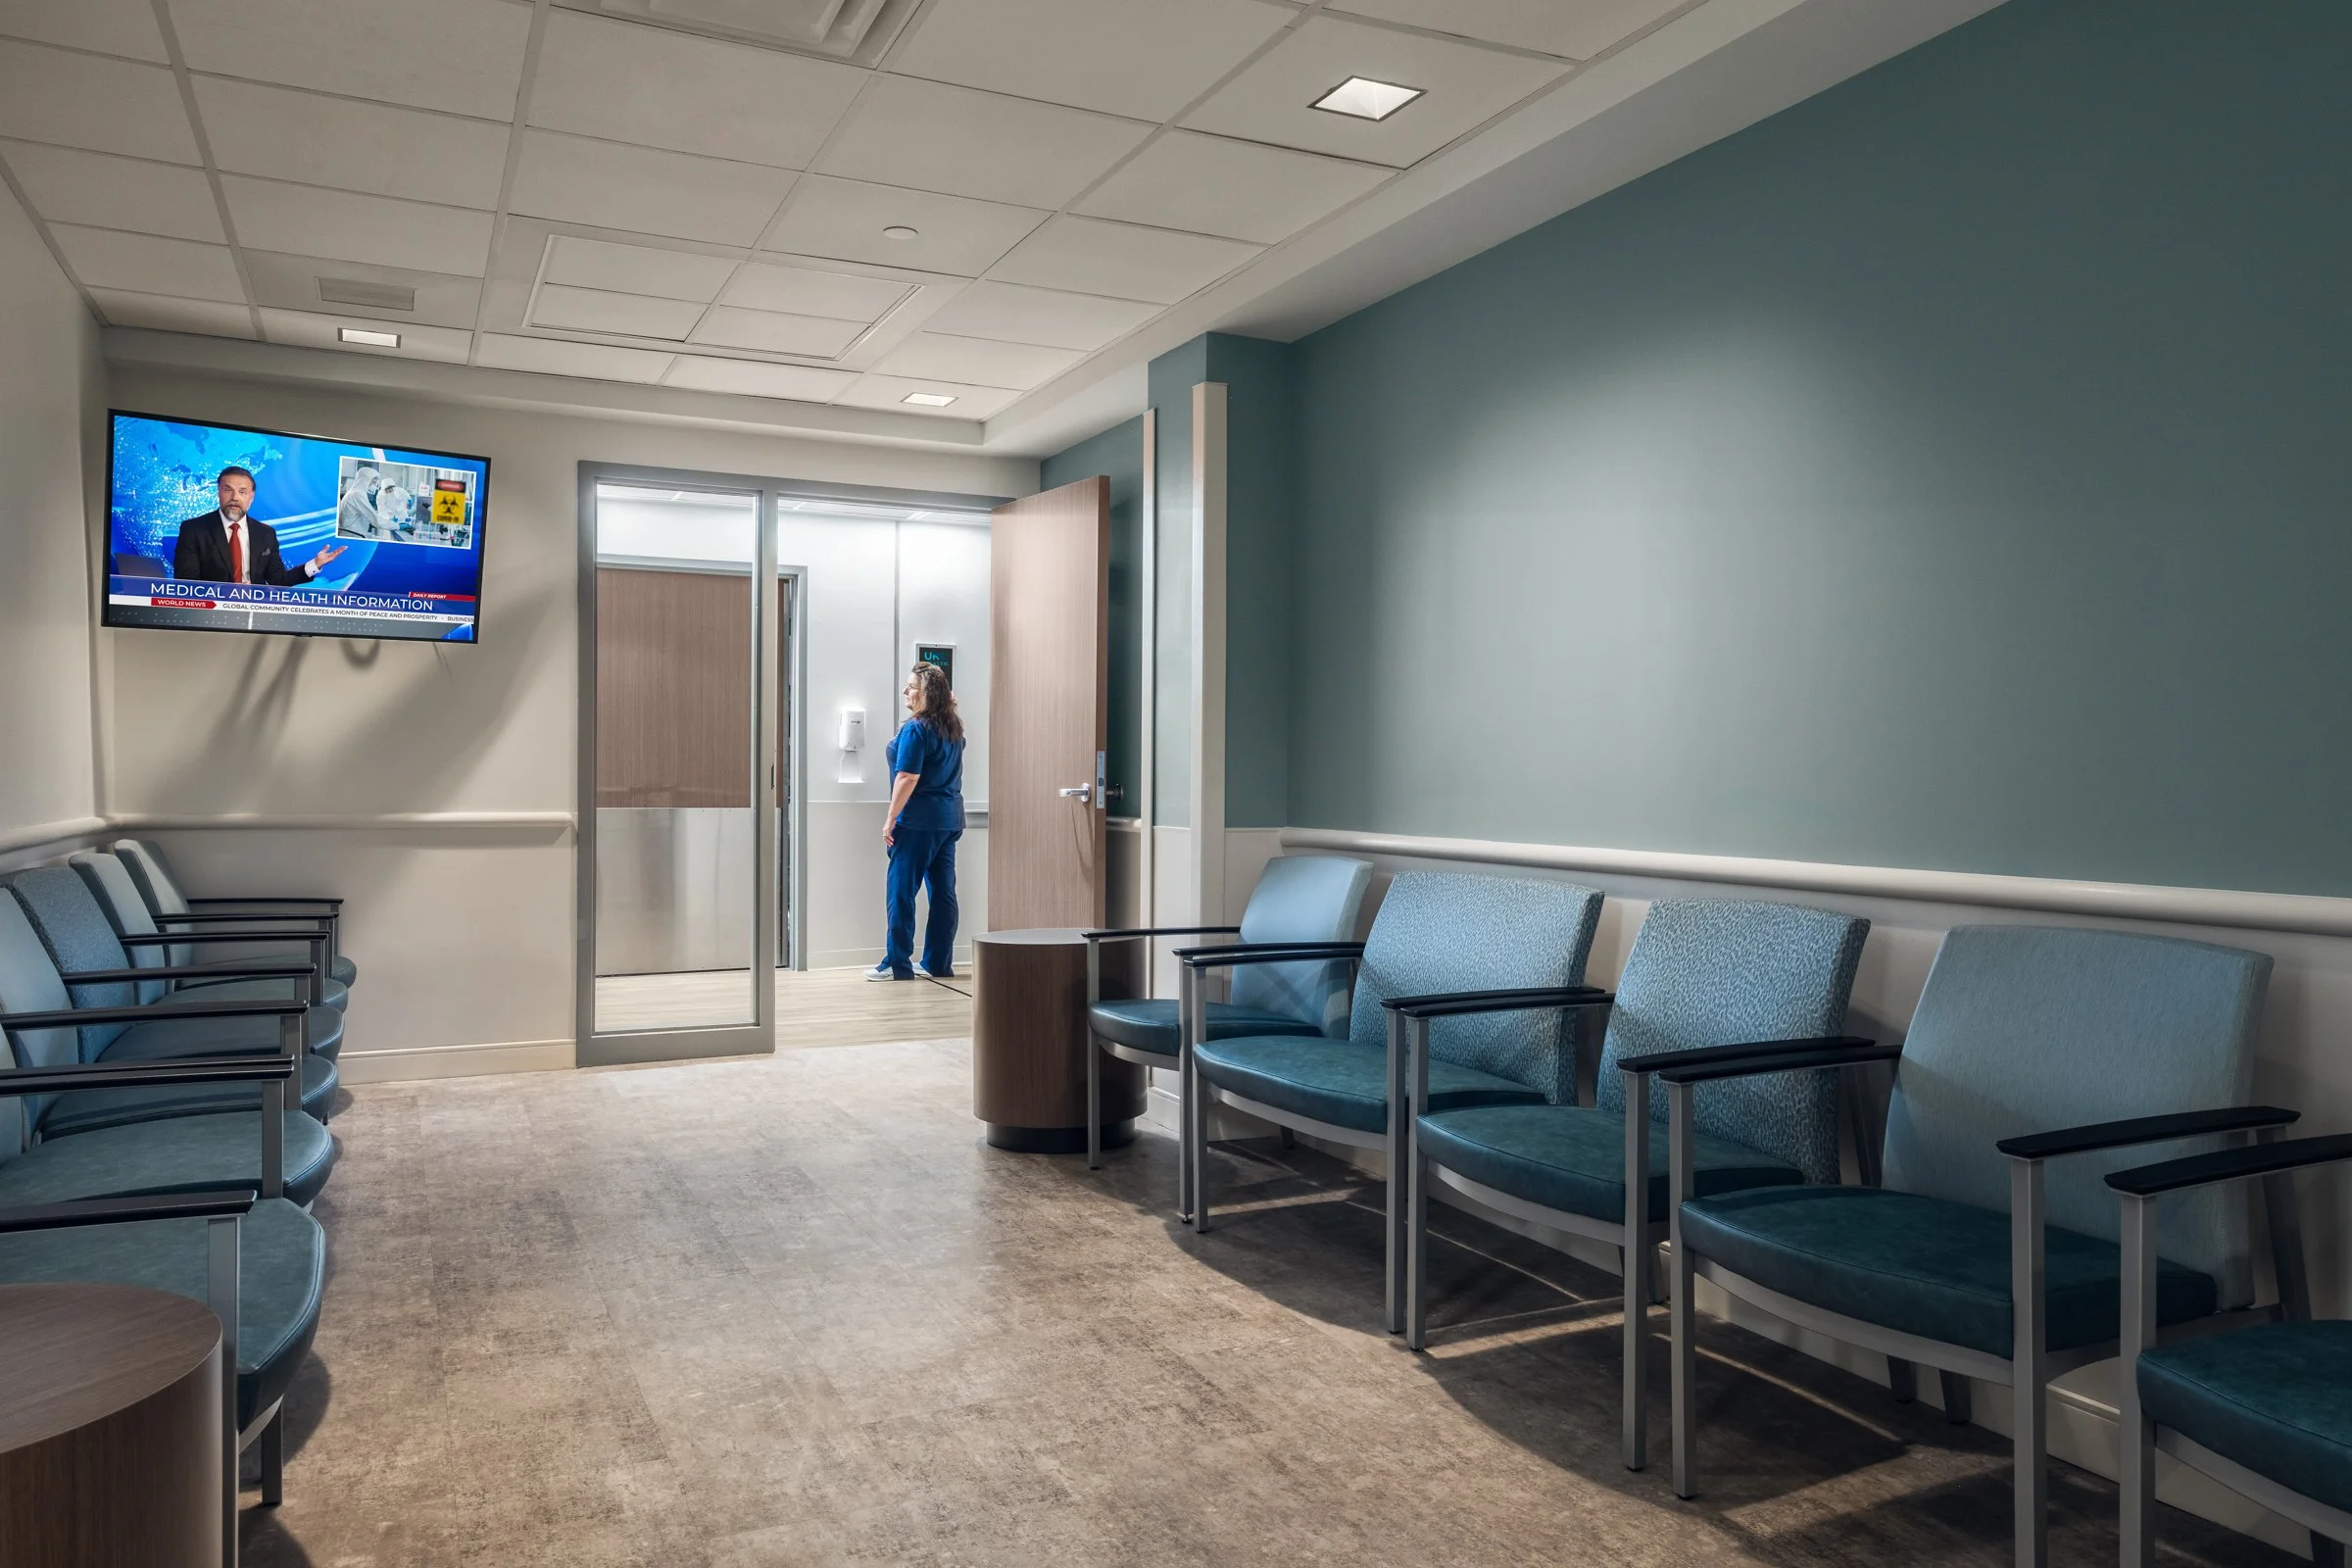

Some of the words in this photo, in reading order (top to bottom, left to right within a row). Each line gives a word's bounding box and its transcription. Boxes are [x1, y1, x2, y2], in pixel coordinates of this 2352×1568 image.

[151, 582, 225, 599] MEDICAL
[229, 588, 265, 601] AND
[270, 591, 327, 605] HEALTH
[332, 595, 433, 612] INFORMATION
[249, 604, 290, 612] COMMUNITY
